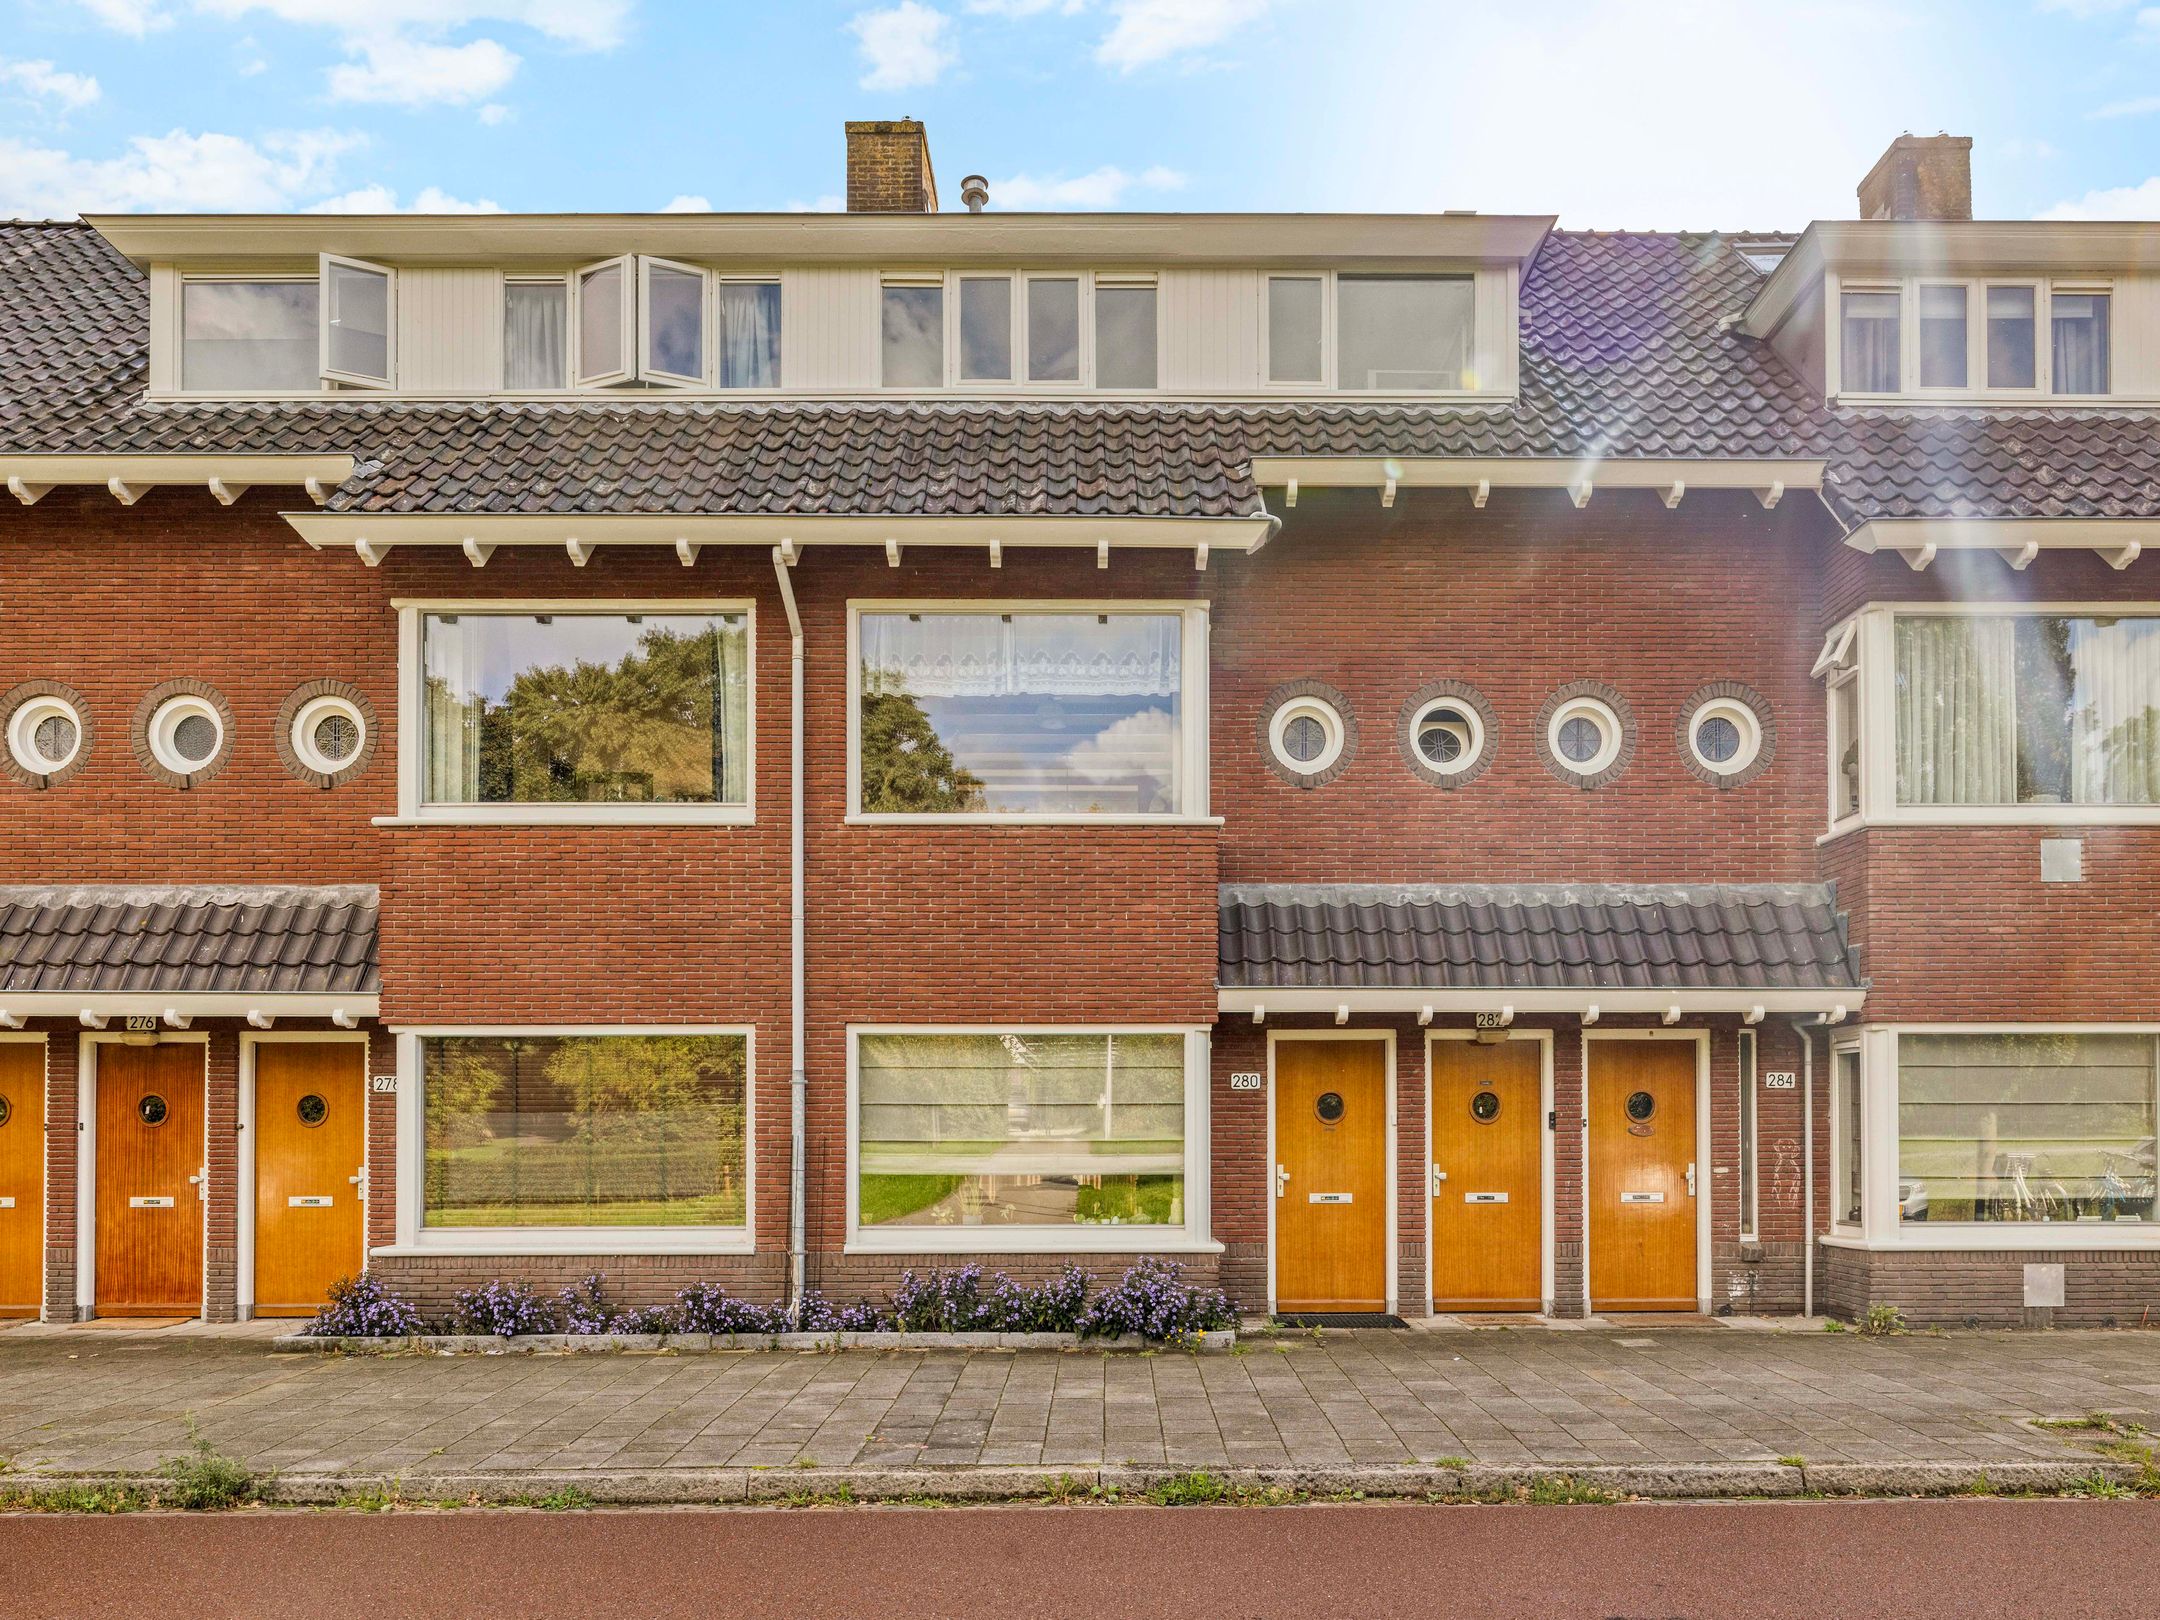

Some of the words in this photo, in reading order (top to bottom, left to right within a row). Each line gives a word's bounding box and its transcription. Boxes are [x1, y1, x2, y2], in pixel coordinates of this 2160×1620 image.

[130, 1016, 154, 1028] 276
[1232, 1074, 1258, 1088] 280
[1768, 1073, 1793, 1087] 284
